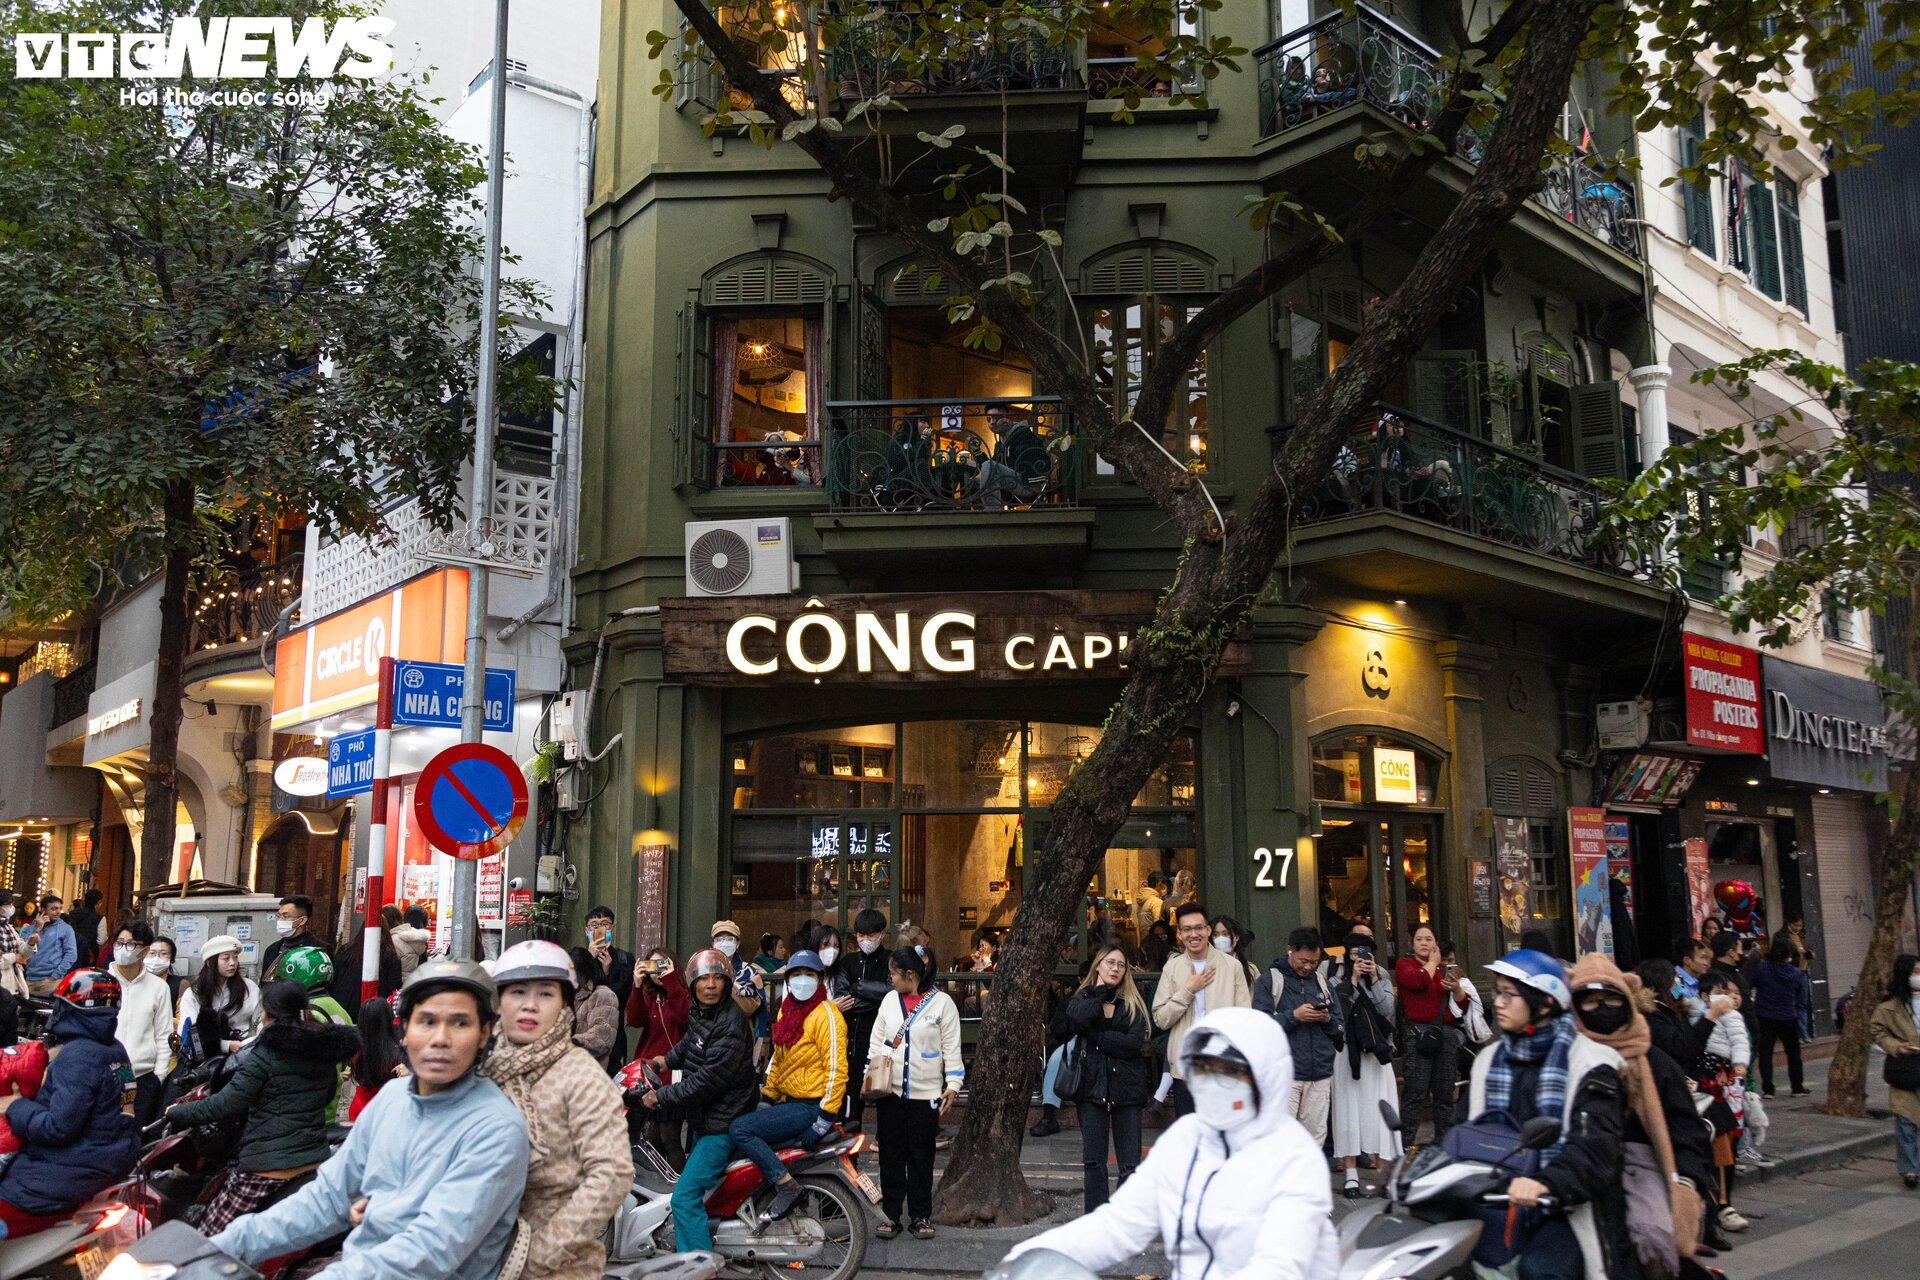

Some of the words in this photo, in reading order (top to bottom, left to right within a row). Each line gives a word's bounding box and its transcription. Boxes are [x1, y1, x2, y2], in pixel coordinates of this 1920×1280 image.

[316, 636, 362, 681] CIRCLE
[725, 598, 976, 685] CỘNG
[1689, 666, 1757, 702] PROPAGANDA
[404, 690, 440, 716] NHÀ
[1713, 700, 1758, 729] POSTERS
[348, 734, 366, 753] PHỐ
[289, 765, 328, 785] Segafred
[331, 759, 350, 787] NHÀ
[354, 753, 374, 782] THỜ
[1253, 847, 1294, 888] 27
